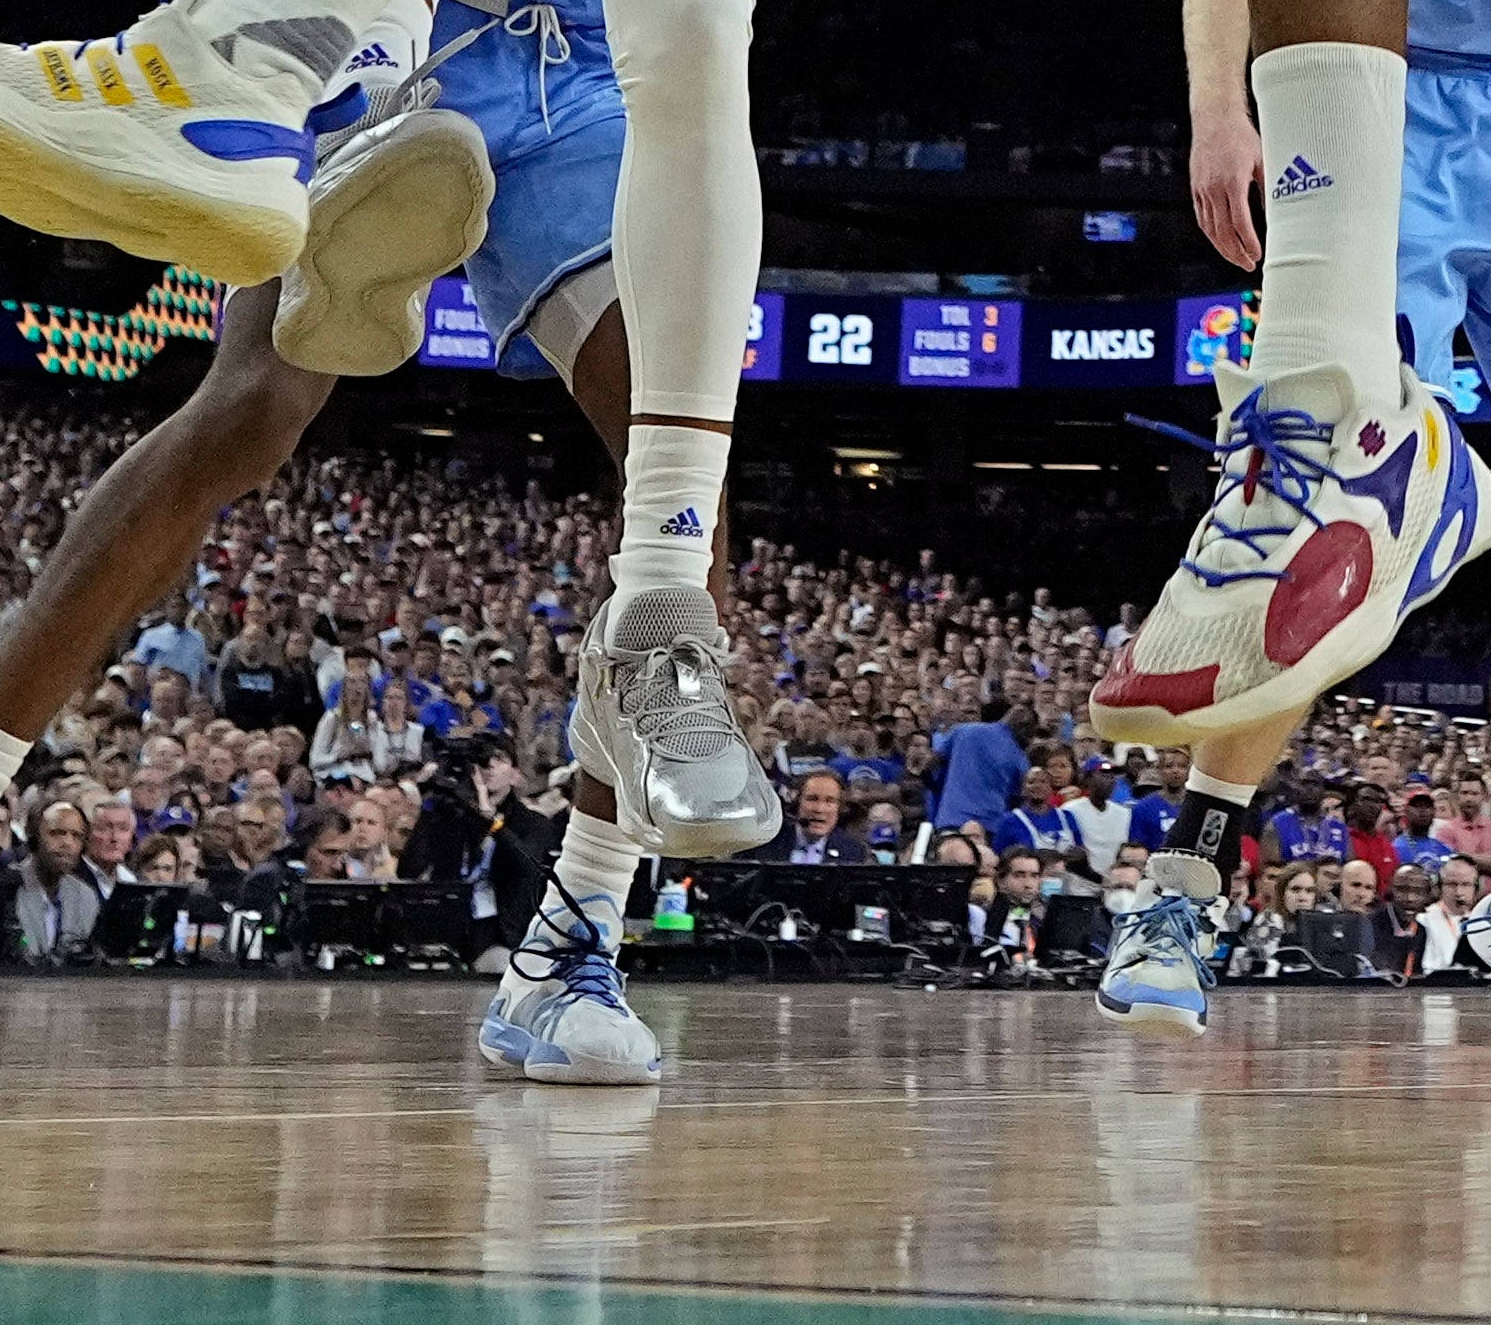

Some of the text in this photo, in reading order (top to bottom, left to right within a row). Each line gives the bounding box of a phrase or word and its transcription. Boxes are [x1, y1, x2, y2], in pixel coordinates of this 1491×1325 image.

[1271, 173, 1334, 201] adidas
[807, 312, 874, 366] 22
[1050, 327, 1156, 361] KANSAS
[659, 523, 704, 539] adidas
